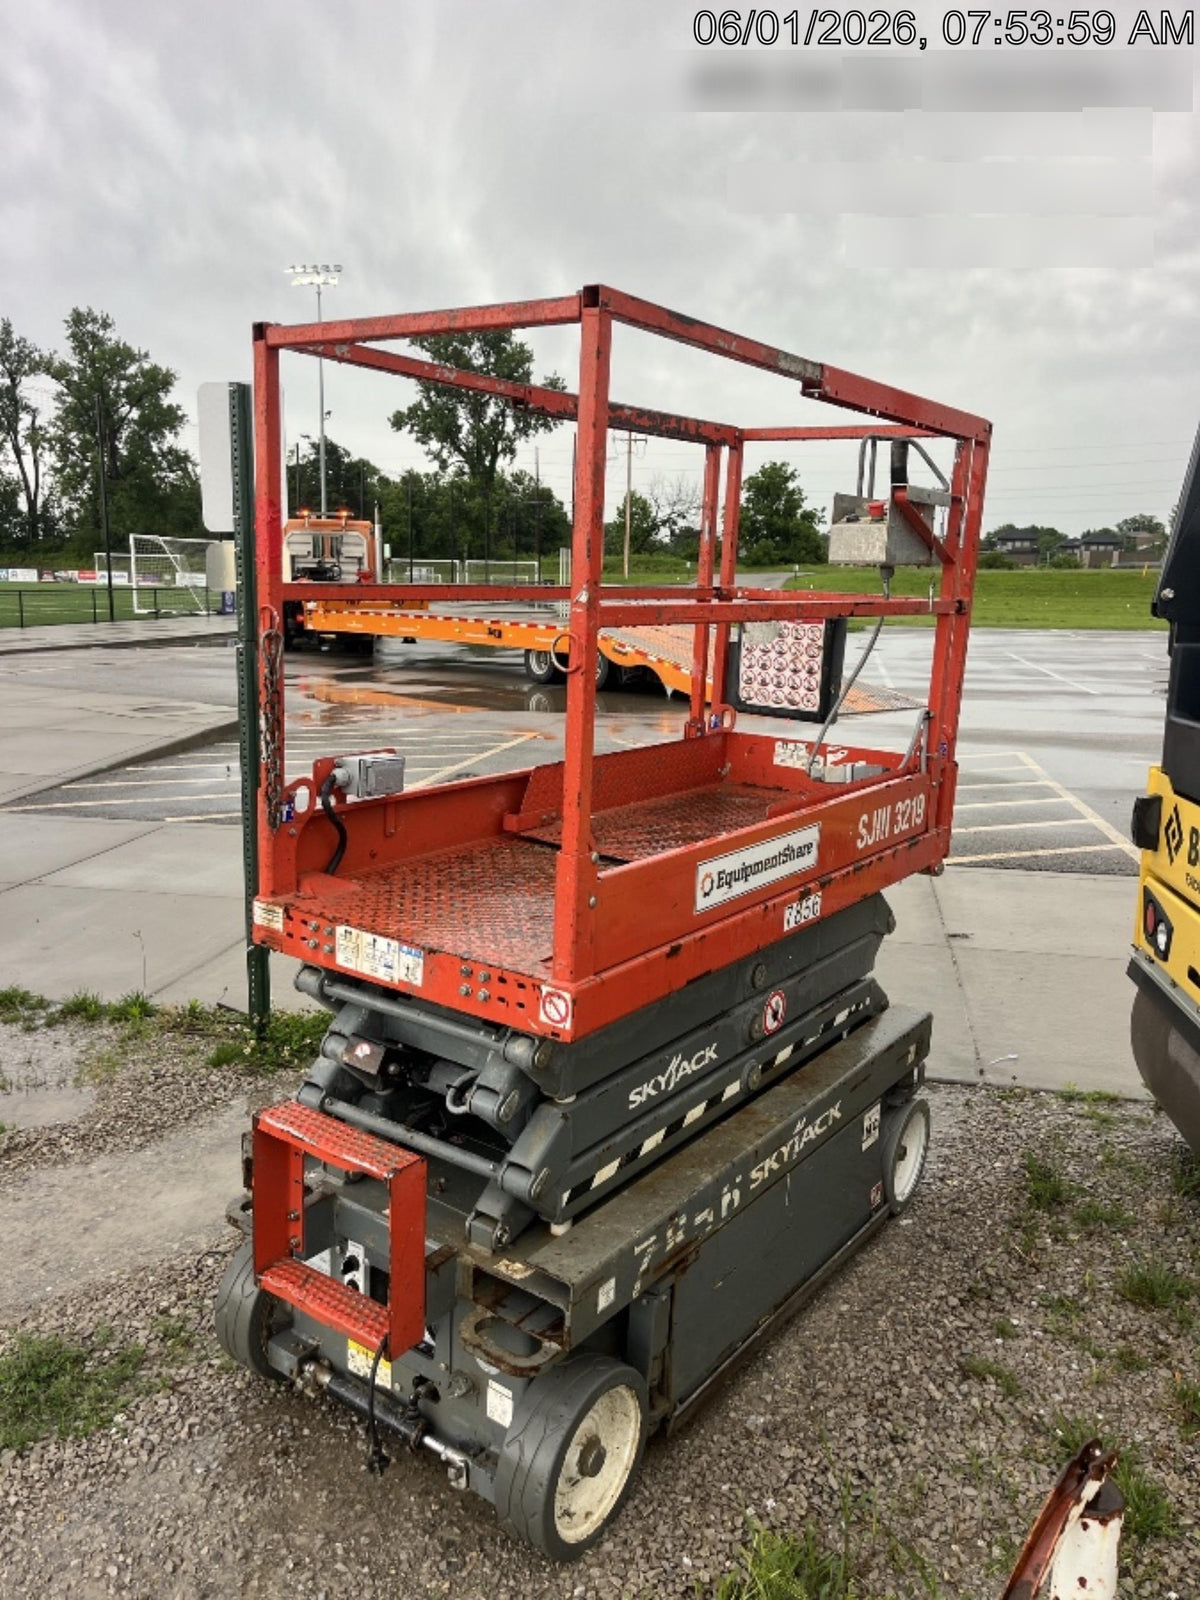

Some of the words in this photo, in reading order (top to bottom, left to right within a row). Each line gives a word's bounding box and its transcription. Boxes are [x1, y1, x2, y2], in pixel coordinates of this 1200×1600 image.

[894, 793, 925, 834] 3219
[716, 842, 813, 890] EquipmentShare
[628, 1042, 719, 1110] SKYJACK
[750, 1100, 842, 1190] SKYJACK
